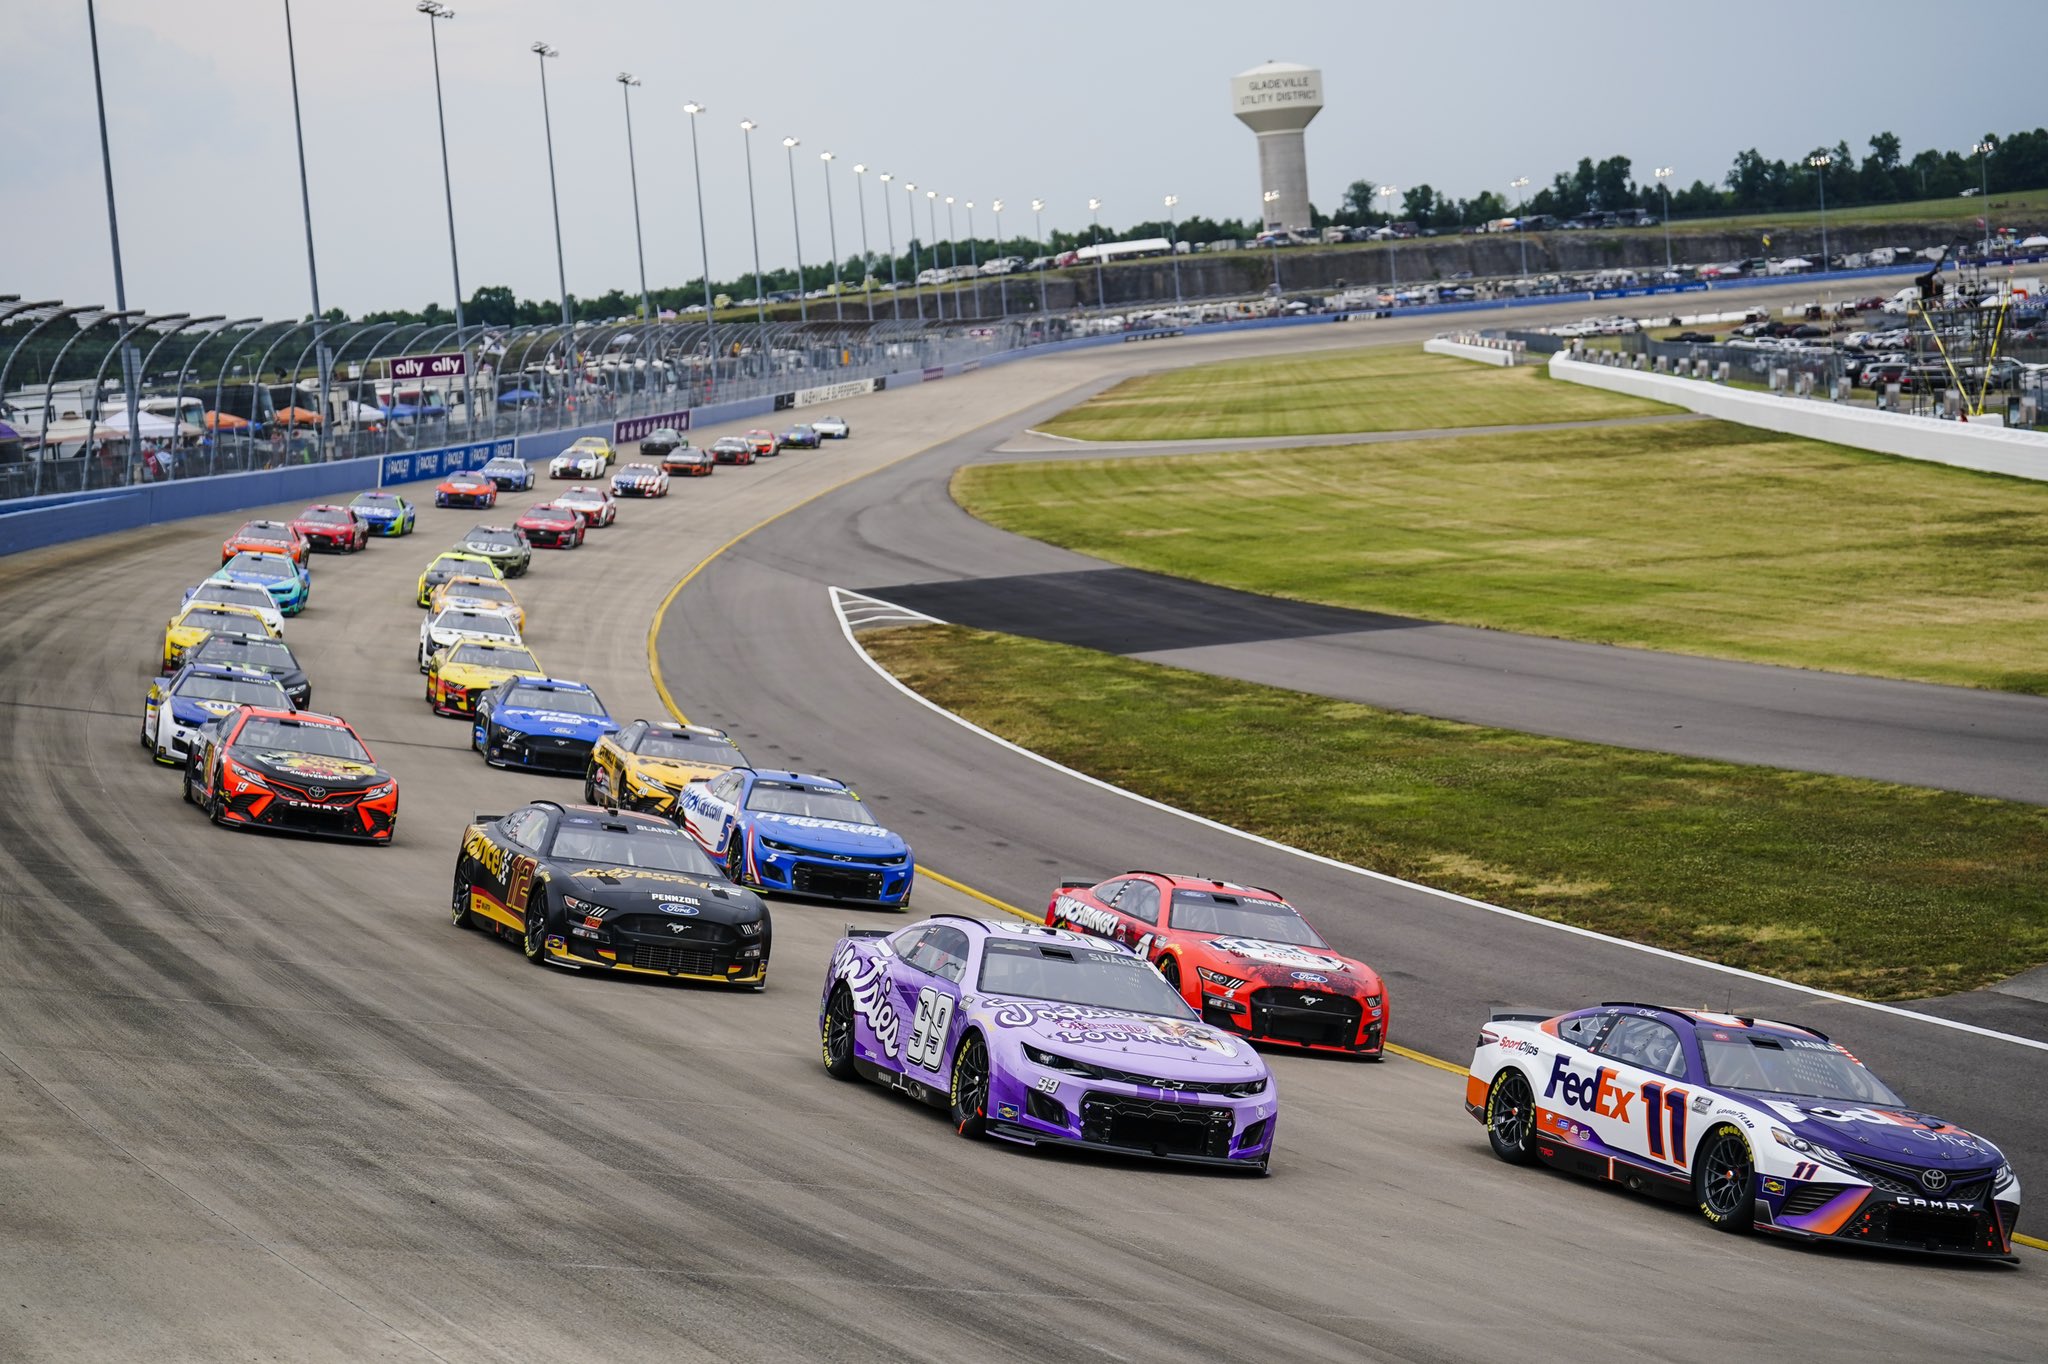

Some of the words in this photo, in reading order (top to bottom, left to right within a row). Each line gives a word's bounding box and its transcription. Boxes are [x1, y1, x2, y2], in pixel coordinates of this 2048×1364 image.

[1249, 77, 1309, 91] GLADEVILLE
[1240, 92, 1273, 106] UTILITY
[1276, 89, 1317, 102] DISTRICT
[395, 359, 424, 377] ally
[431, 356, 461, 374] ally
[390, 458, 410, 474] RACKLEY
[420, 454, 438, 471] RACKLEY
[299, 720, 332, 731] TRUEX
[235, 780, 249, 793] 19
[638, 786, 649, 796] 20
[289, 800, 343, 812] CAMRY
[637, 825, 679, 836] BLANEY
[716, 814, 735, 853] 5
[766, 853, 779, 863] 5
[506, 854, 537, 914] 12
[651, 893, 700, 906] PENNZOIL
[1134, 932, 1154, 960] 4
[1088, 953, 1148, 969] SUÁREZ
[907, 985, 955, 1073] 99
[1036, 1077, 1060, 1094] 99
[1543, 1052, 1636, 1124] FedEx
[1640, 1081, 1690, 1169] 11
[1792, 1161, 1820, 1181] 11
[1896, 1196, 1976, 1213] CAMRY
